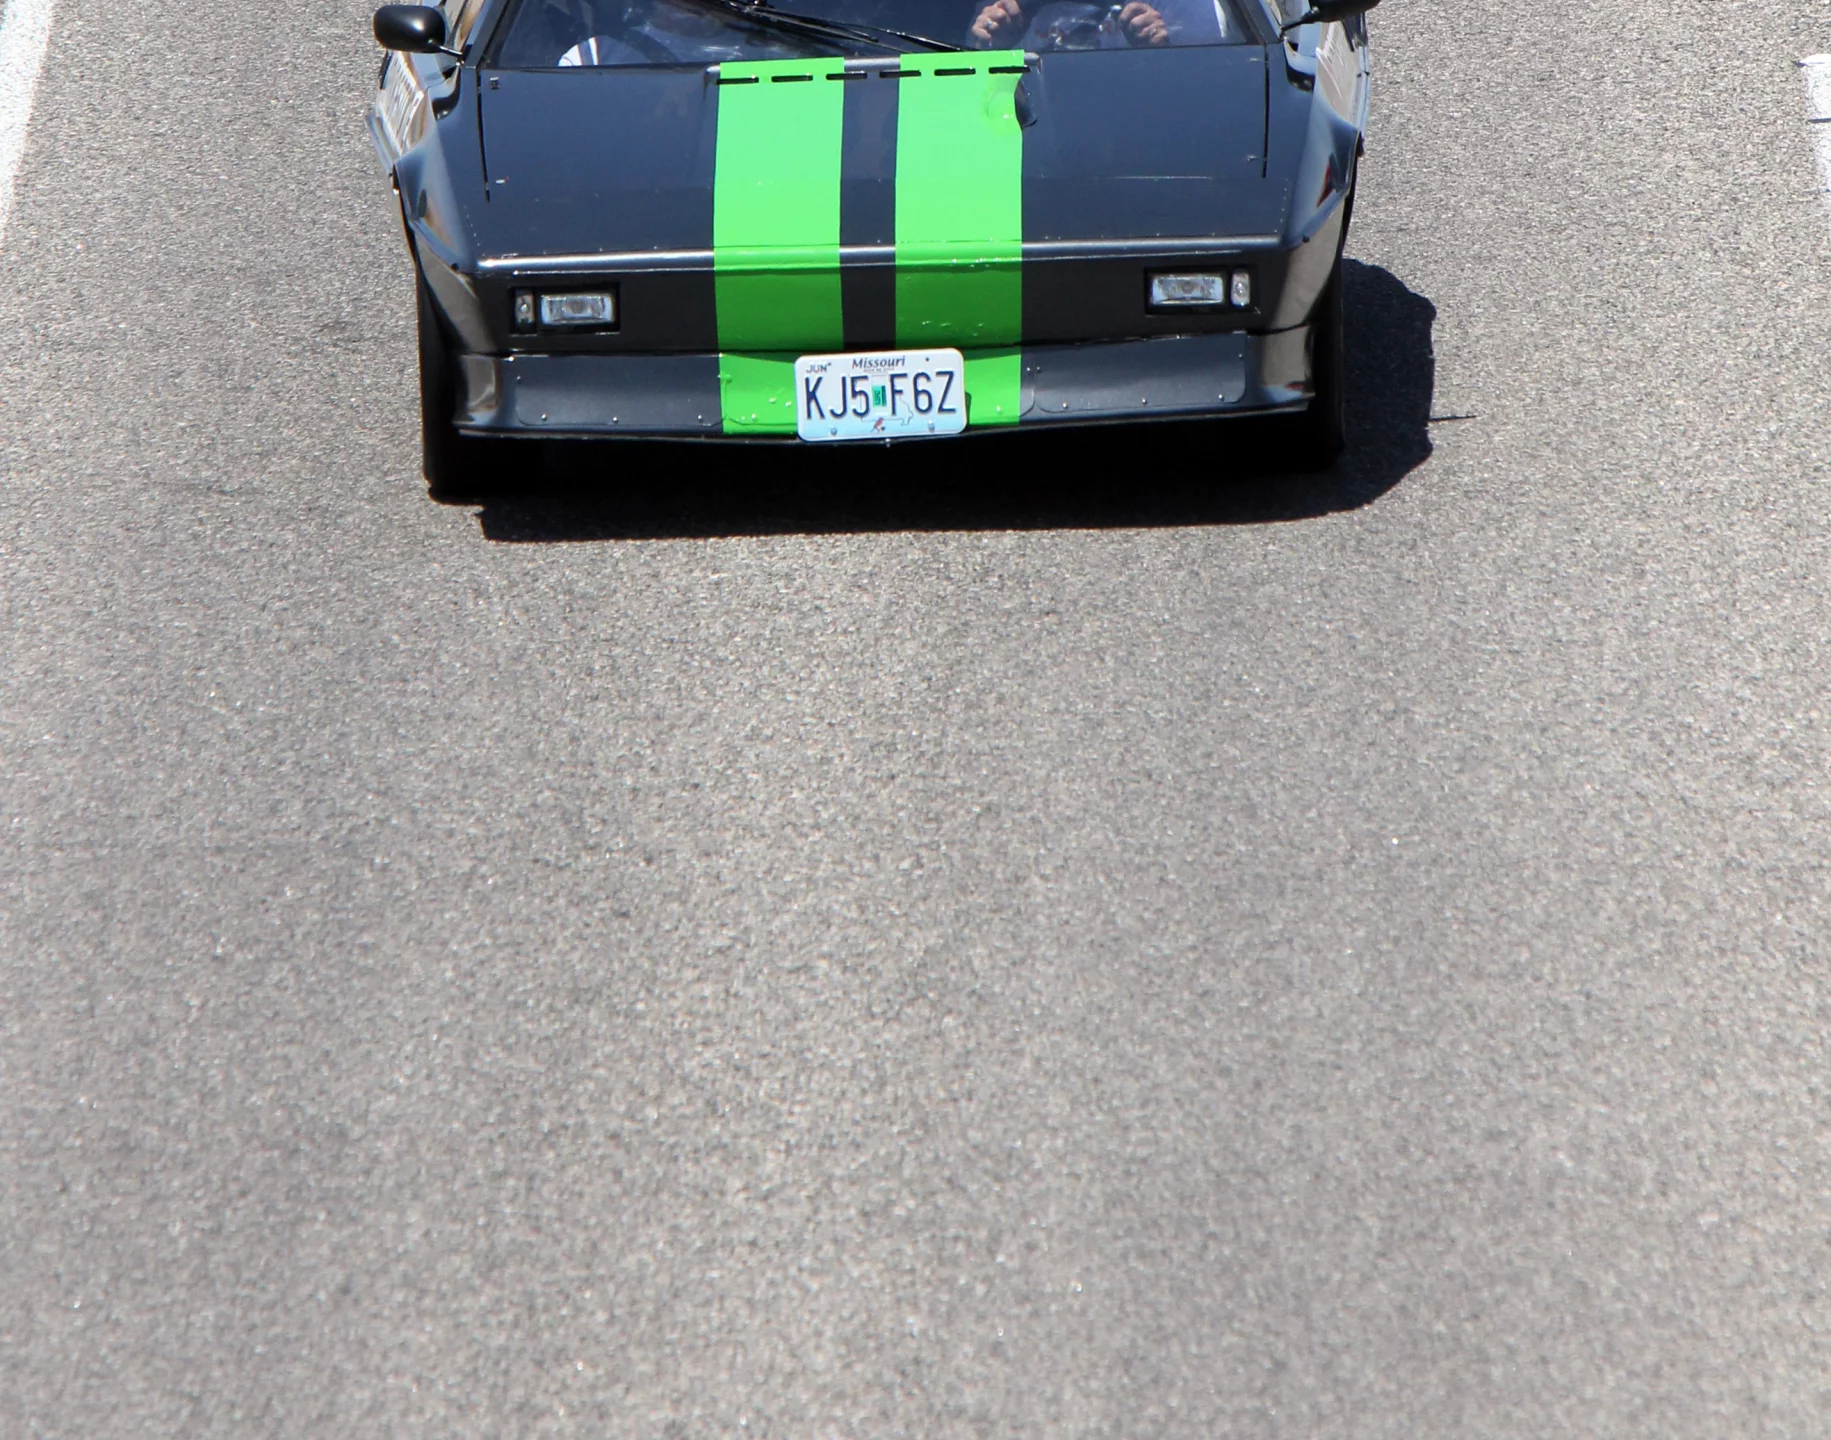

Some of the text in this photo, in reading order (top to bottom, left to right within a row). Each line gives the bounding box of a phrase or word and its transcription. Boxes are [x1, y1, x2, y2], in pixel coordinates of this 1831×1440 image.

[805, 363, 828, 374] JUN
[852, 355, 906, 369] Missouri
[805, 375, 871, 420] KJ5
[890, 371, 957, 417] F6Z
